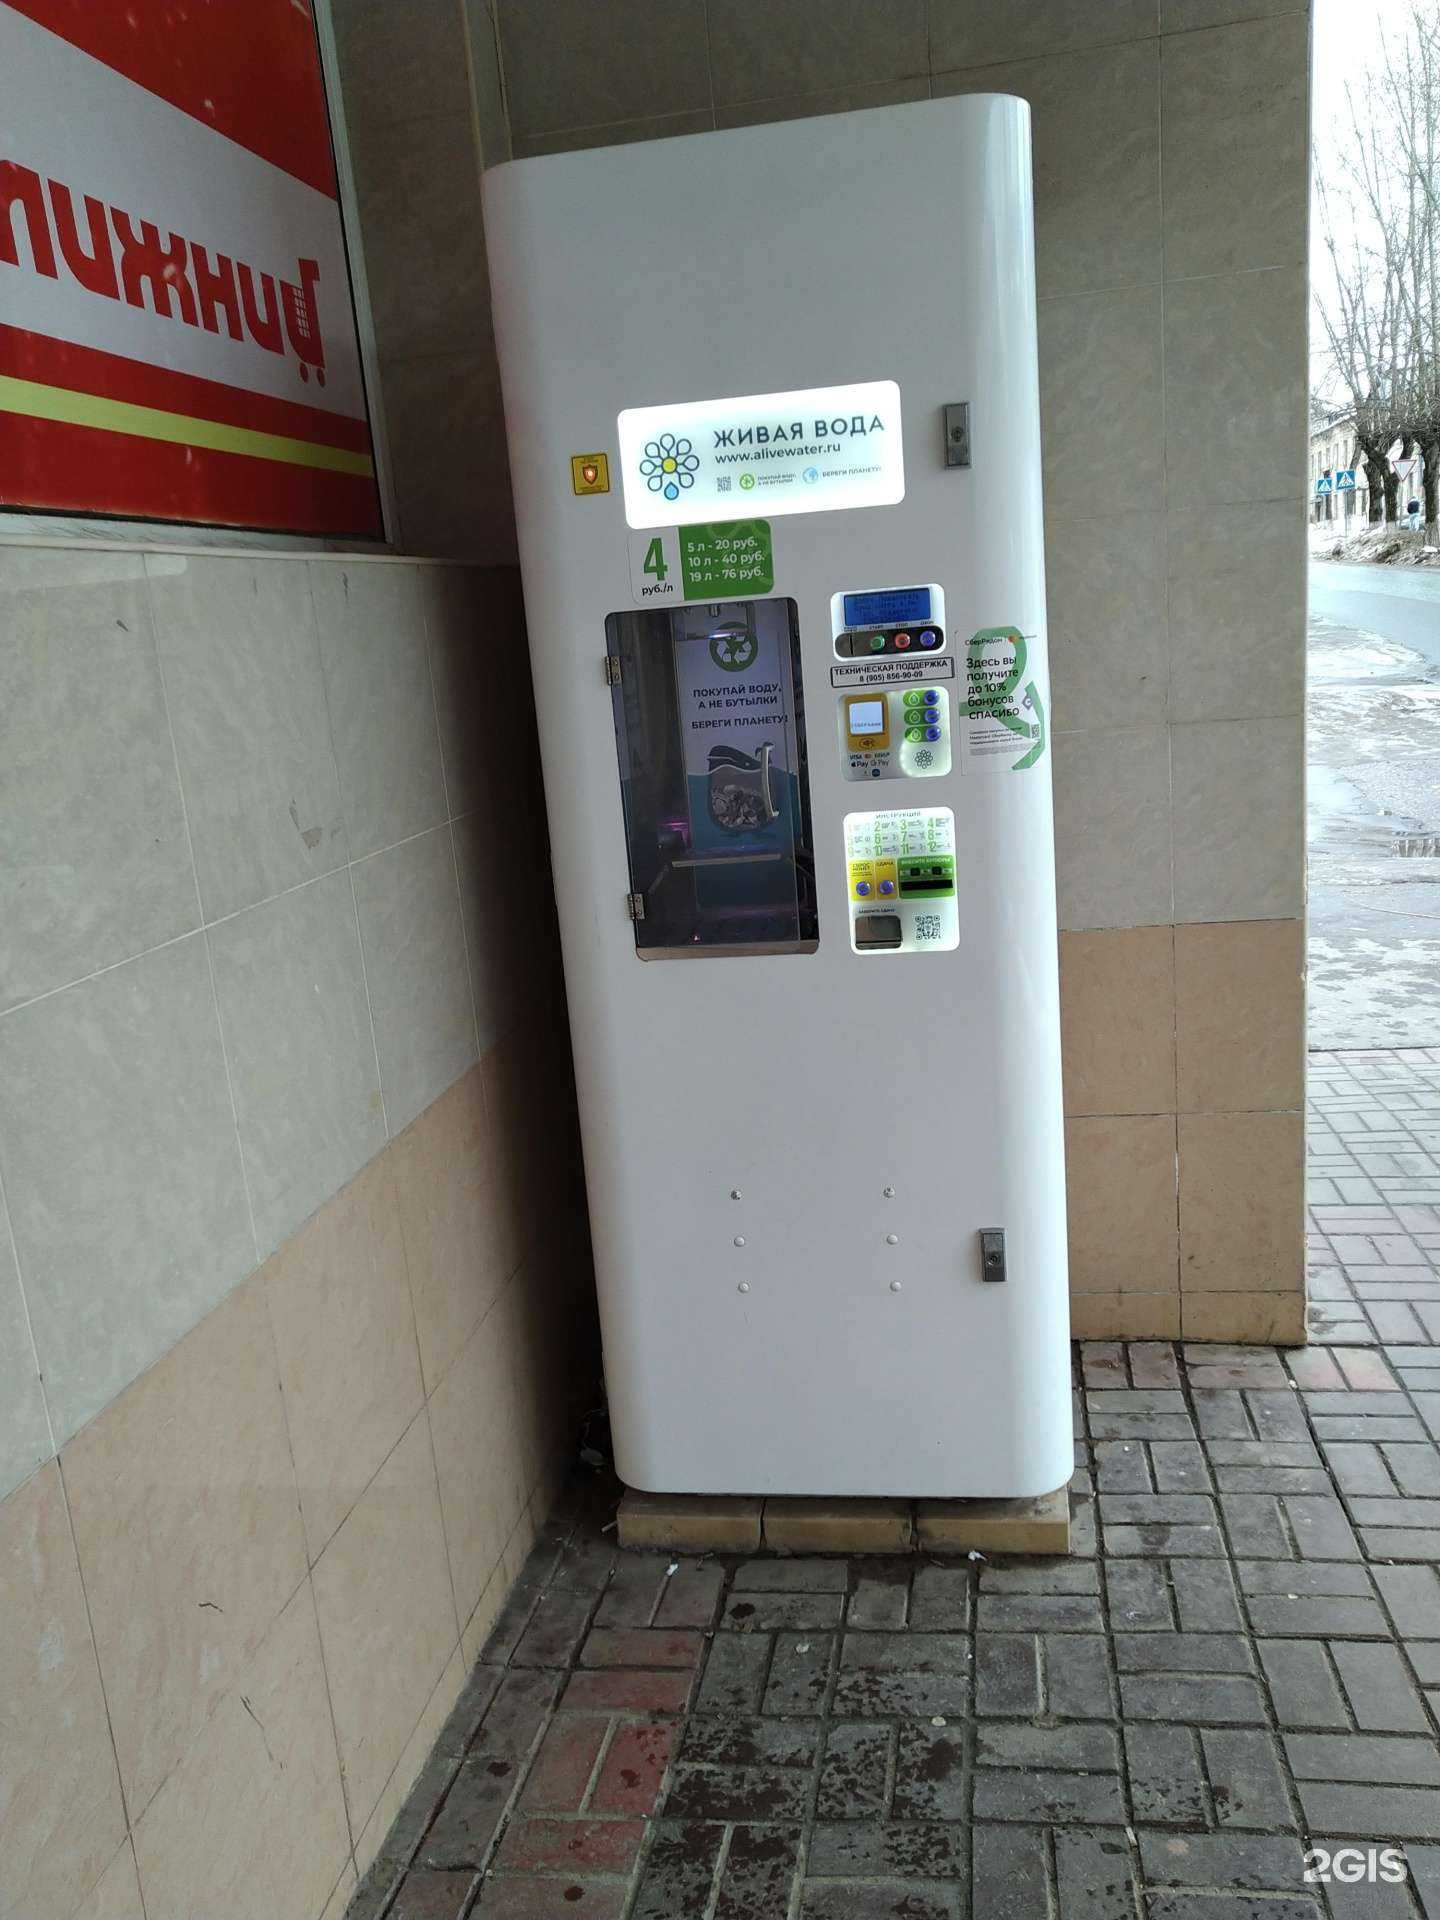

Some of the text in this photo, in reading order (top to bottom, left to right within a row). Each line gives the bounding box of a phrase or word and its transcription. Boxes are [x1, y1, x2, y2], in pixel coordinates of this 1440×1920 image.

[714, 414, 885, 448] ЖИВАЯ ВОДА
[714, 443, 841, 464] www.alivewater.ru
[687, 542, 694, 552] 5
[697, 543, 705, 552] л
[715, 539, 729, 550] 20
[733, 536, 758, 550] руб.
[643, 537, 668, 581] 4
[689, 556, 701, 567] 10
[703, 558, 711, 566] л
[722, 553, 737, 564] 40
[740, 551, 765, 564] руб.
[689, 572, 701, 582] 19
[704, 572, 712, 580] л
[722, 568, 737, 579] 76
[740, 566, 765, 580] руб.
[642, 582, 673, 596] руб./л
[834, 660, 948, 676] ТЕХНИЧЕСКАЯ ПОДДЕРЖКА
[966, 657, 1017, 670] Здесь вы
[866, 673, 885, 682] (905)
[967, 669, 1019, 681] получите
[693, 684, 745, 698] ПОКУПАЙ
[968, 683, 1007, 695] до 10%
[698, 695, 778, 710] А НЕ БУТЫЛКИ
[968, 695, 1014, 707] бонусов
[969, 708, 1020, 720] СПАСИБО
[692, 714, 788, 730] БЕРЕГИ ПЛАНЕТУ!
